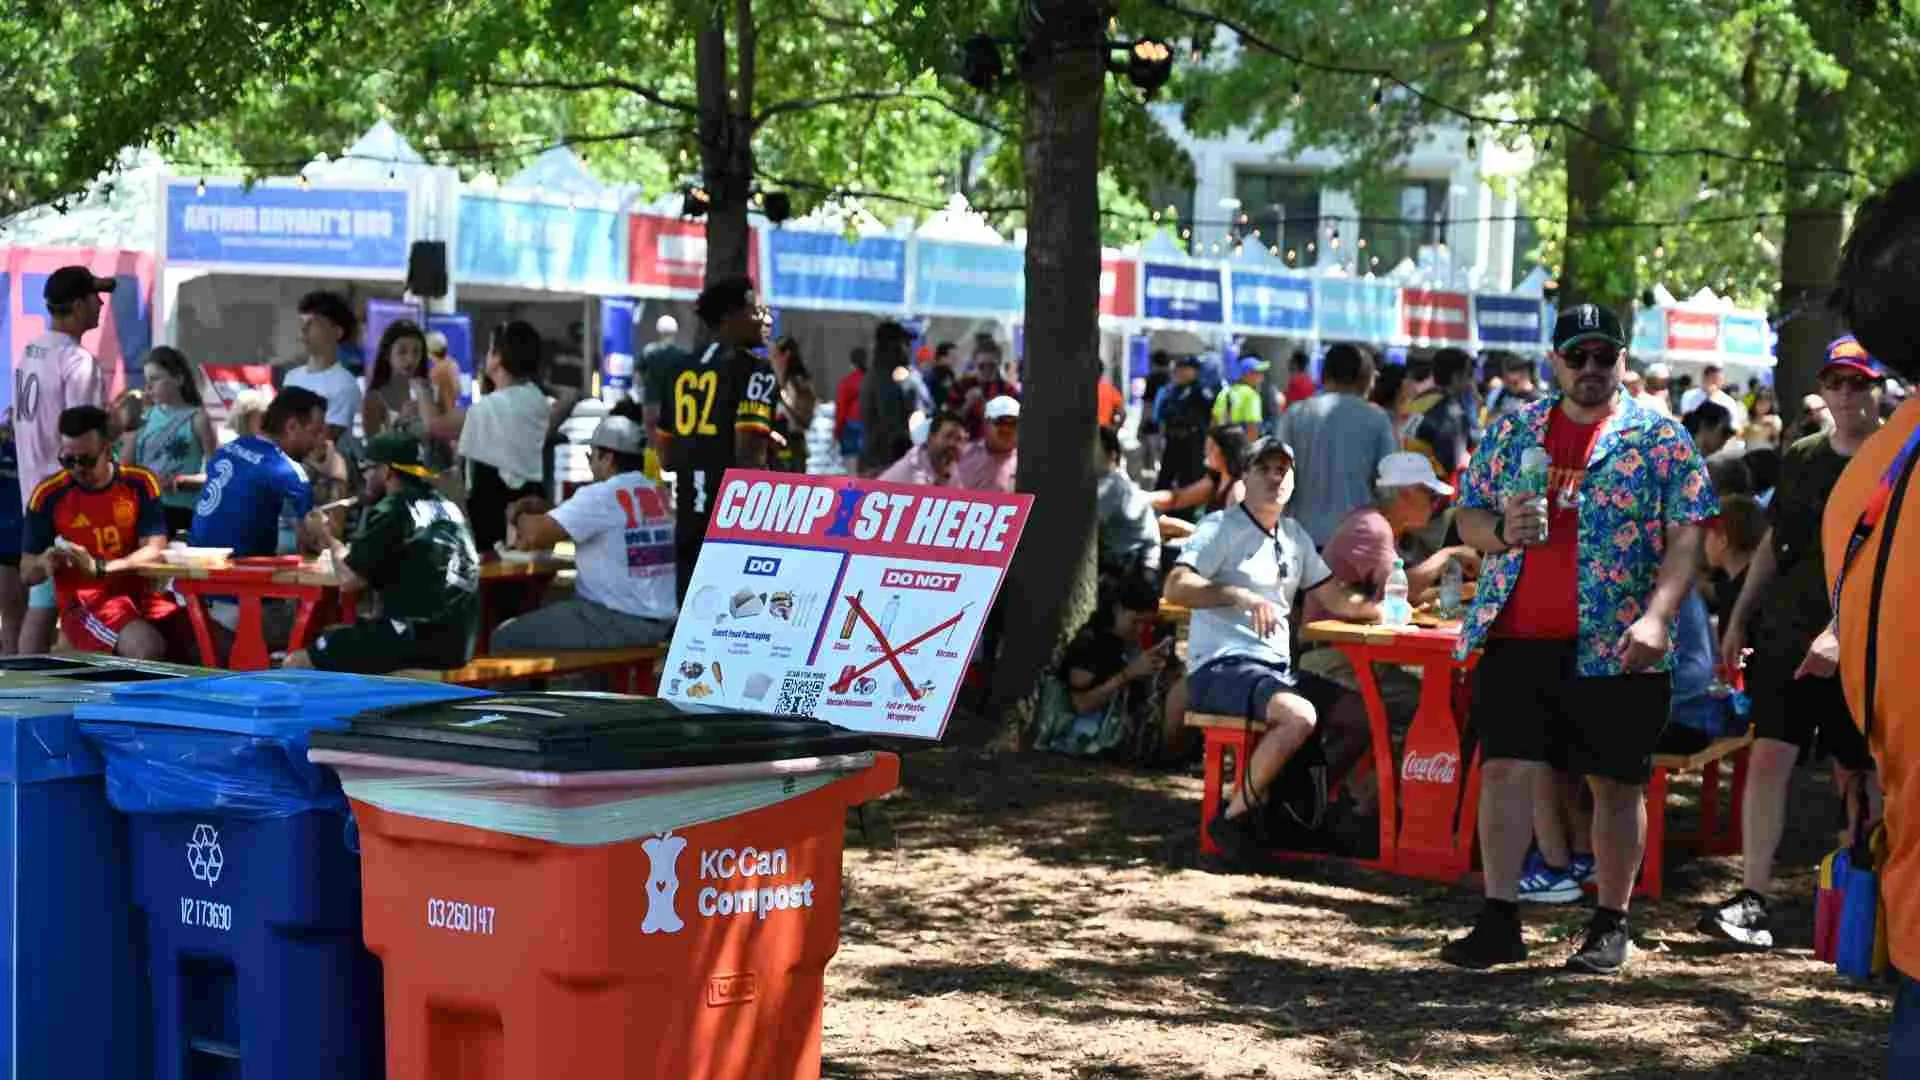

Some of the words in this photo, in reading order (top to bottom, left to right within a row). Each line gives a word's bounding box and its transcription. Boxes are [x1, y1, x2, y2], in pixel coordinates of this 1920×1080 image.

[675, 369, 718, 435] 62
[747, 371, 776, 404] 62
[716, 480, 914, 541] COMPST
[906, 497, 1018, 551] HERE
[748, 559, 775, 573] DO
[885, 571, 914, 585] DO
[915, 575, 956, 589] NOT
[700, 848, 737, 880] KC
[738, 846, 788, 877] Can
[427, 897, 496, 935] 03260147
[698, 878, 815, 920] Compost
